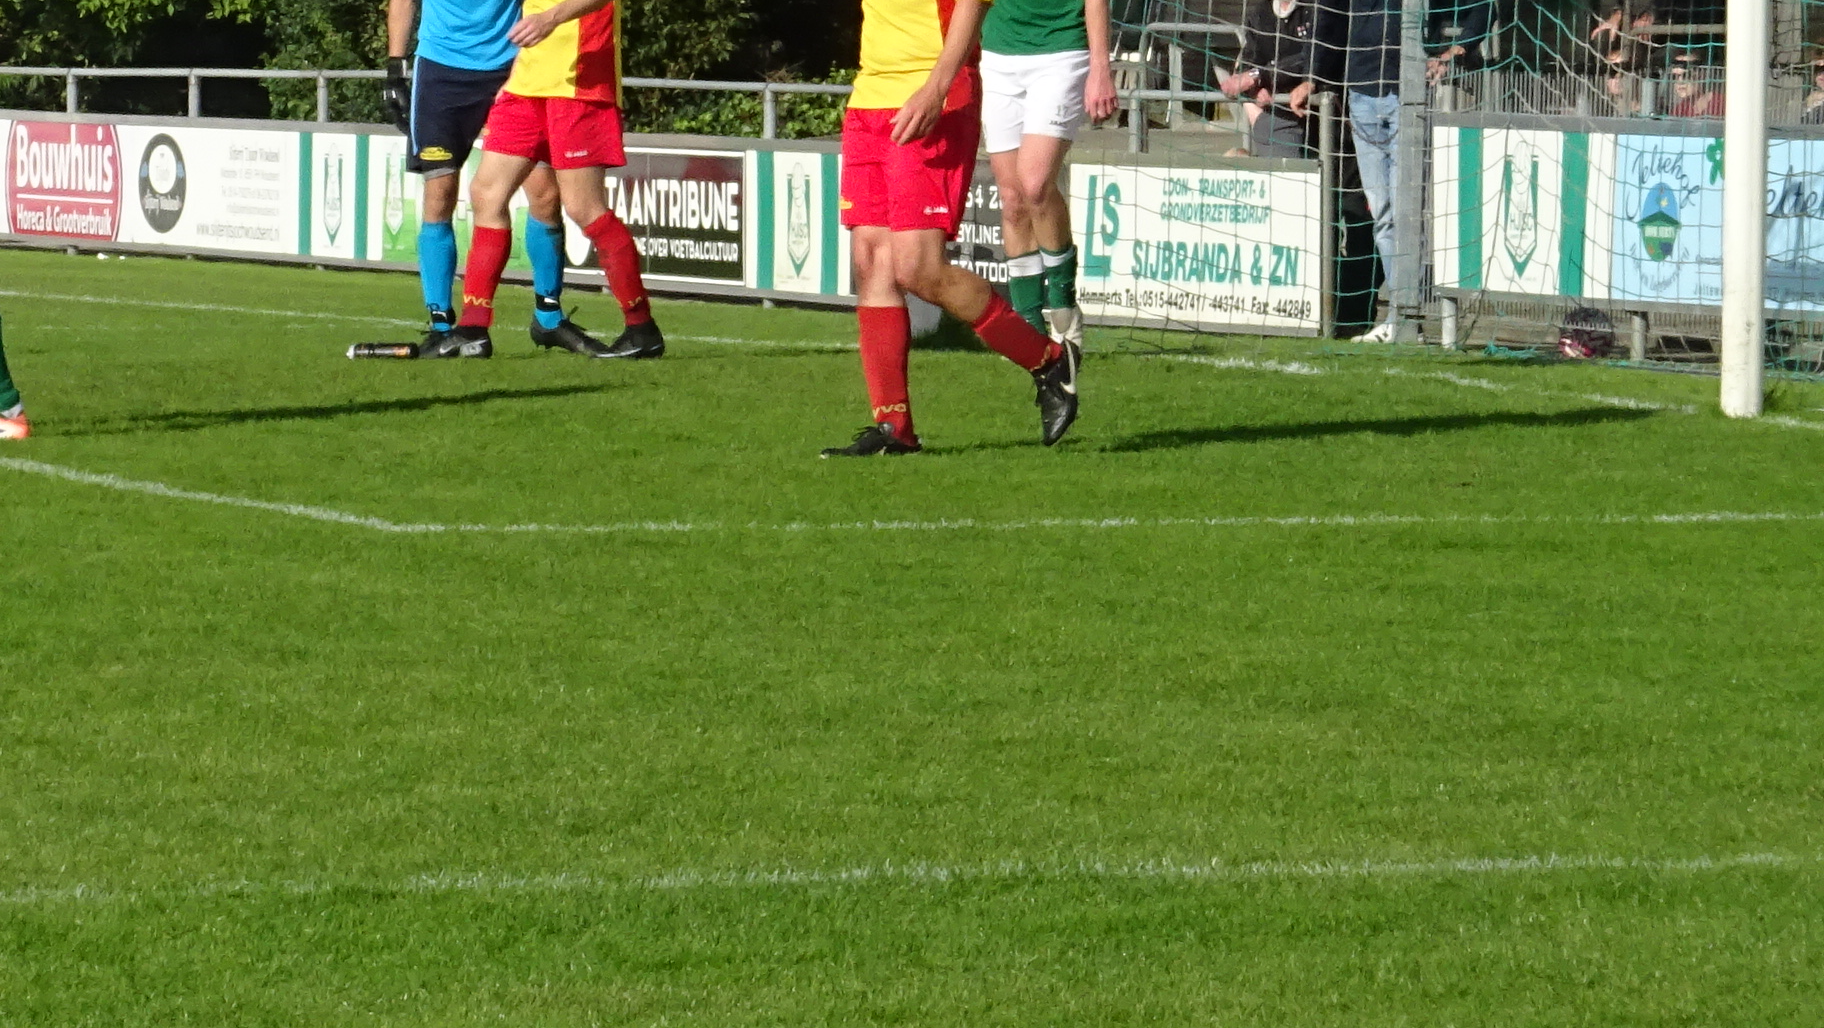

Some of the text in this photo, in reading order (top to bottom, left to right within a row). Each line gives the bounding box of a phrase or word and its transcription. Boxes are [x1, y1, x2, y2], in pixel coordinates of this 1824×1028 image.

[15, 125, 114, 194] Bouwhuis
[1198, 178, 1257, 199] TRANSPORT-
[604, 176, 739, 232] TAANTRIBUNE
[1161, 203, 1271, 225] GRONDVERZETBEDRIJF
[16, 203, 112, 238] Horeca & Grootverbruik
[648, 237, 668, 257] OVER
[1132, 239, 1299, 287] SIJBRANDA & ZN
[1079, 287, 1122, 306] Hommerts
